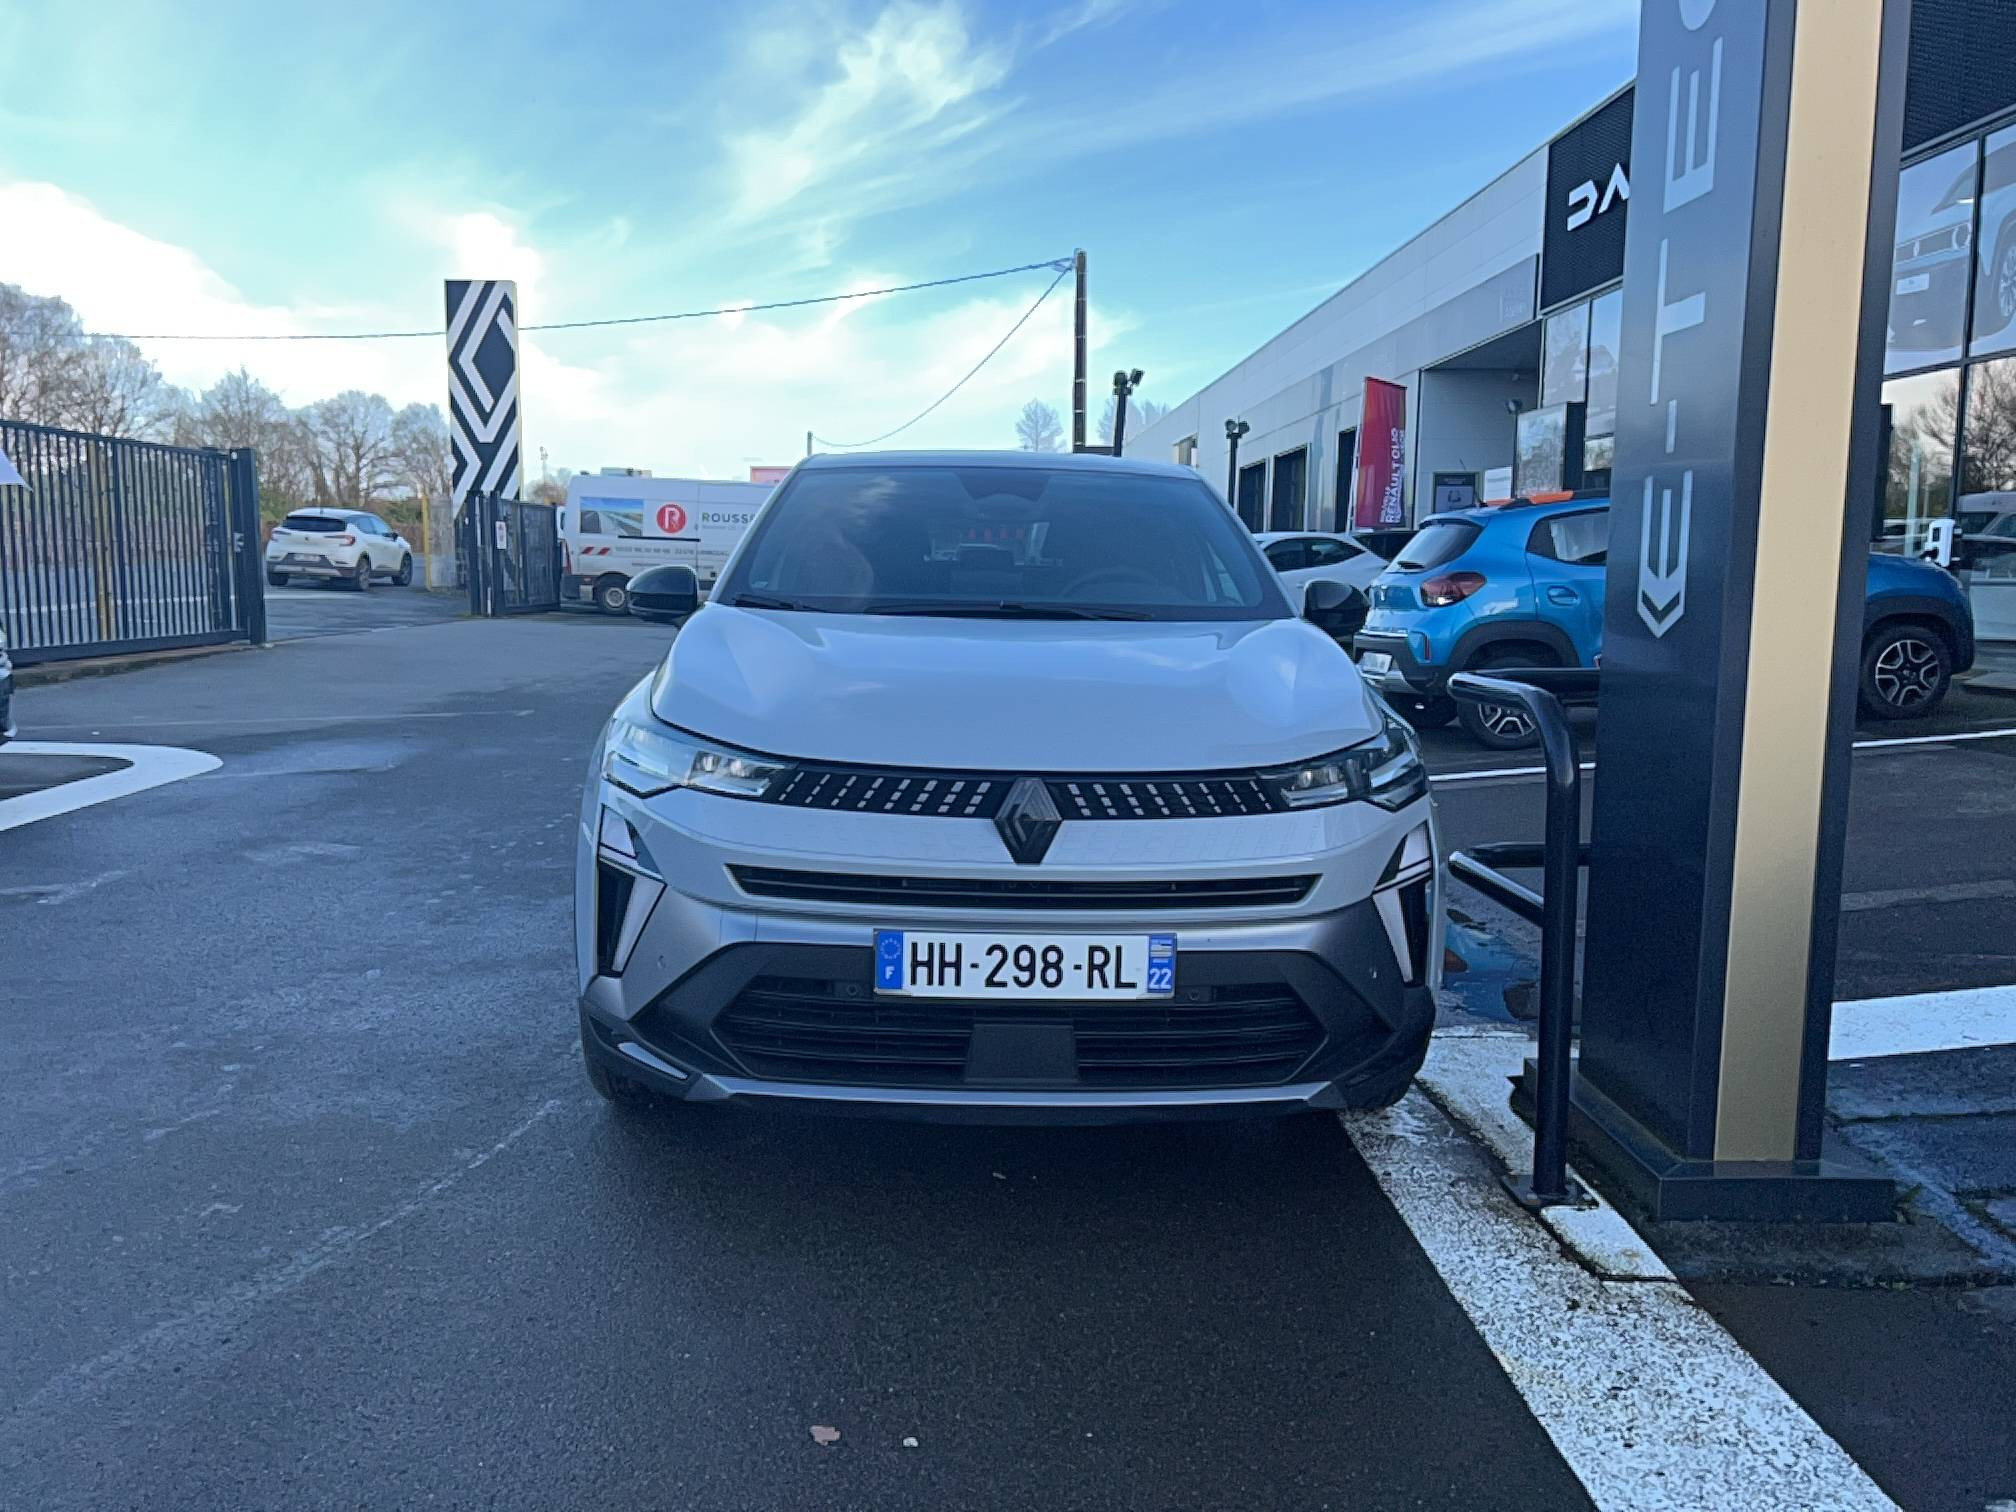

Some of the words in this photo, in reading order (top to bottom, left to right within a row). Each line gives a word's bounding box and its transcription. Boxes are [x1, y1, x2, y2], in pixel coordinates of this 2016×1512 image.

[1637, 0, 1723, 638] E-TE
[1385, 461, 1399, 522] RENAULT
[885, 967, 895, 980] F
[910, 942, 1137, 989] HH-298-RL
[1149, 968, 1172, 989] 22
